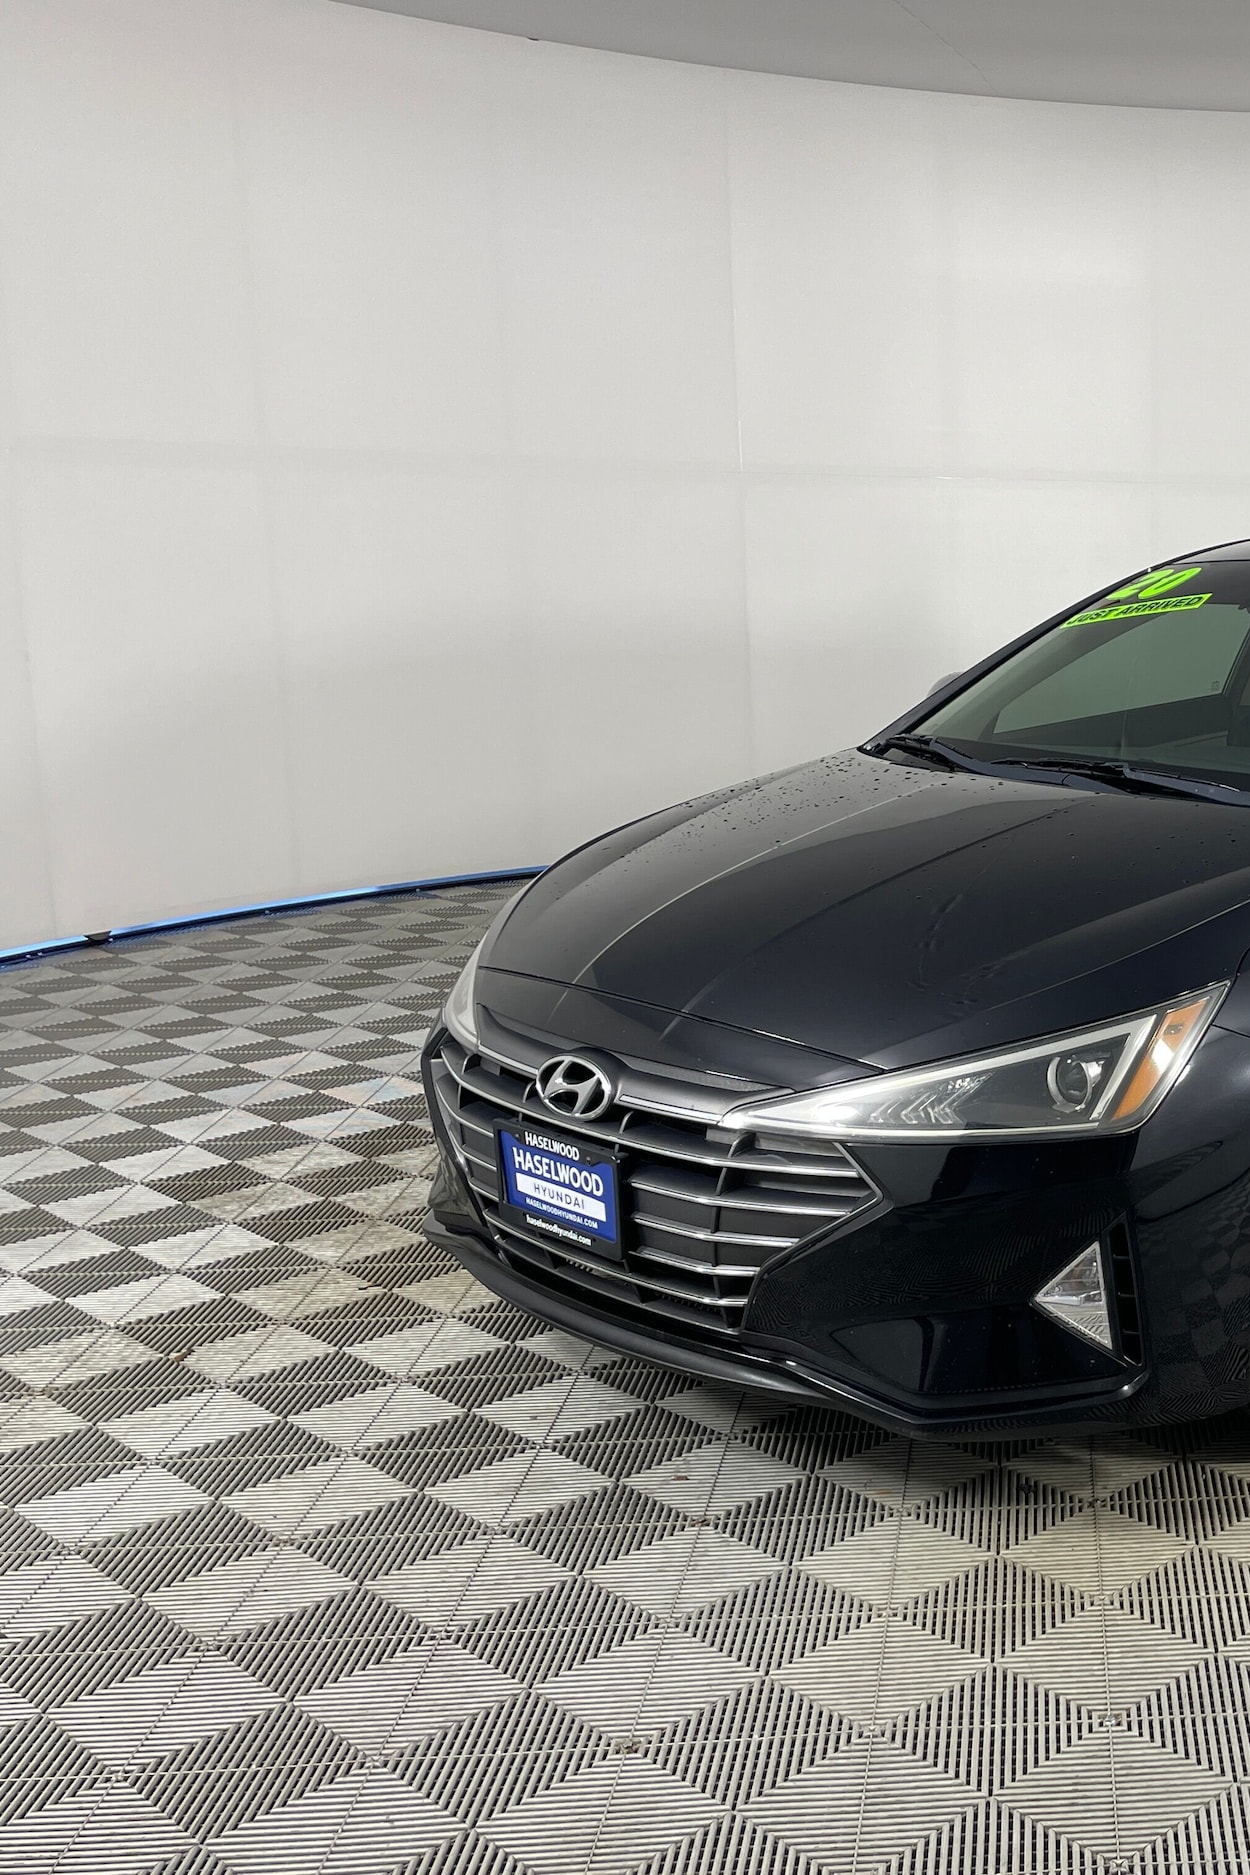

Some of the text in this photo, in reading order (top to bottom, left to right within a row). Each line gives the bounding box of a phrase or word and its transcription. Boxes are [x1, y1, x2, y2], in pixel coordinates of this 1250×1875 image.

[1067, 595, 1204, 625] JUST ARRIVED
[524, 1131, 580, 1161] HASELWOOD
[512, 1146, 604, 1197] HASELWOOD
[533, 1182, 585, 1210] HYUNDAI
[525, 1197, 599, 1230] HASELWOODHYUNDAI.COM
[526, 1214, 592, 1246] haselwoodhyundai.com
